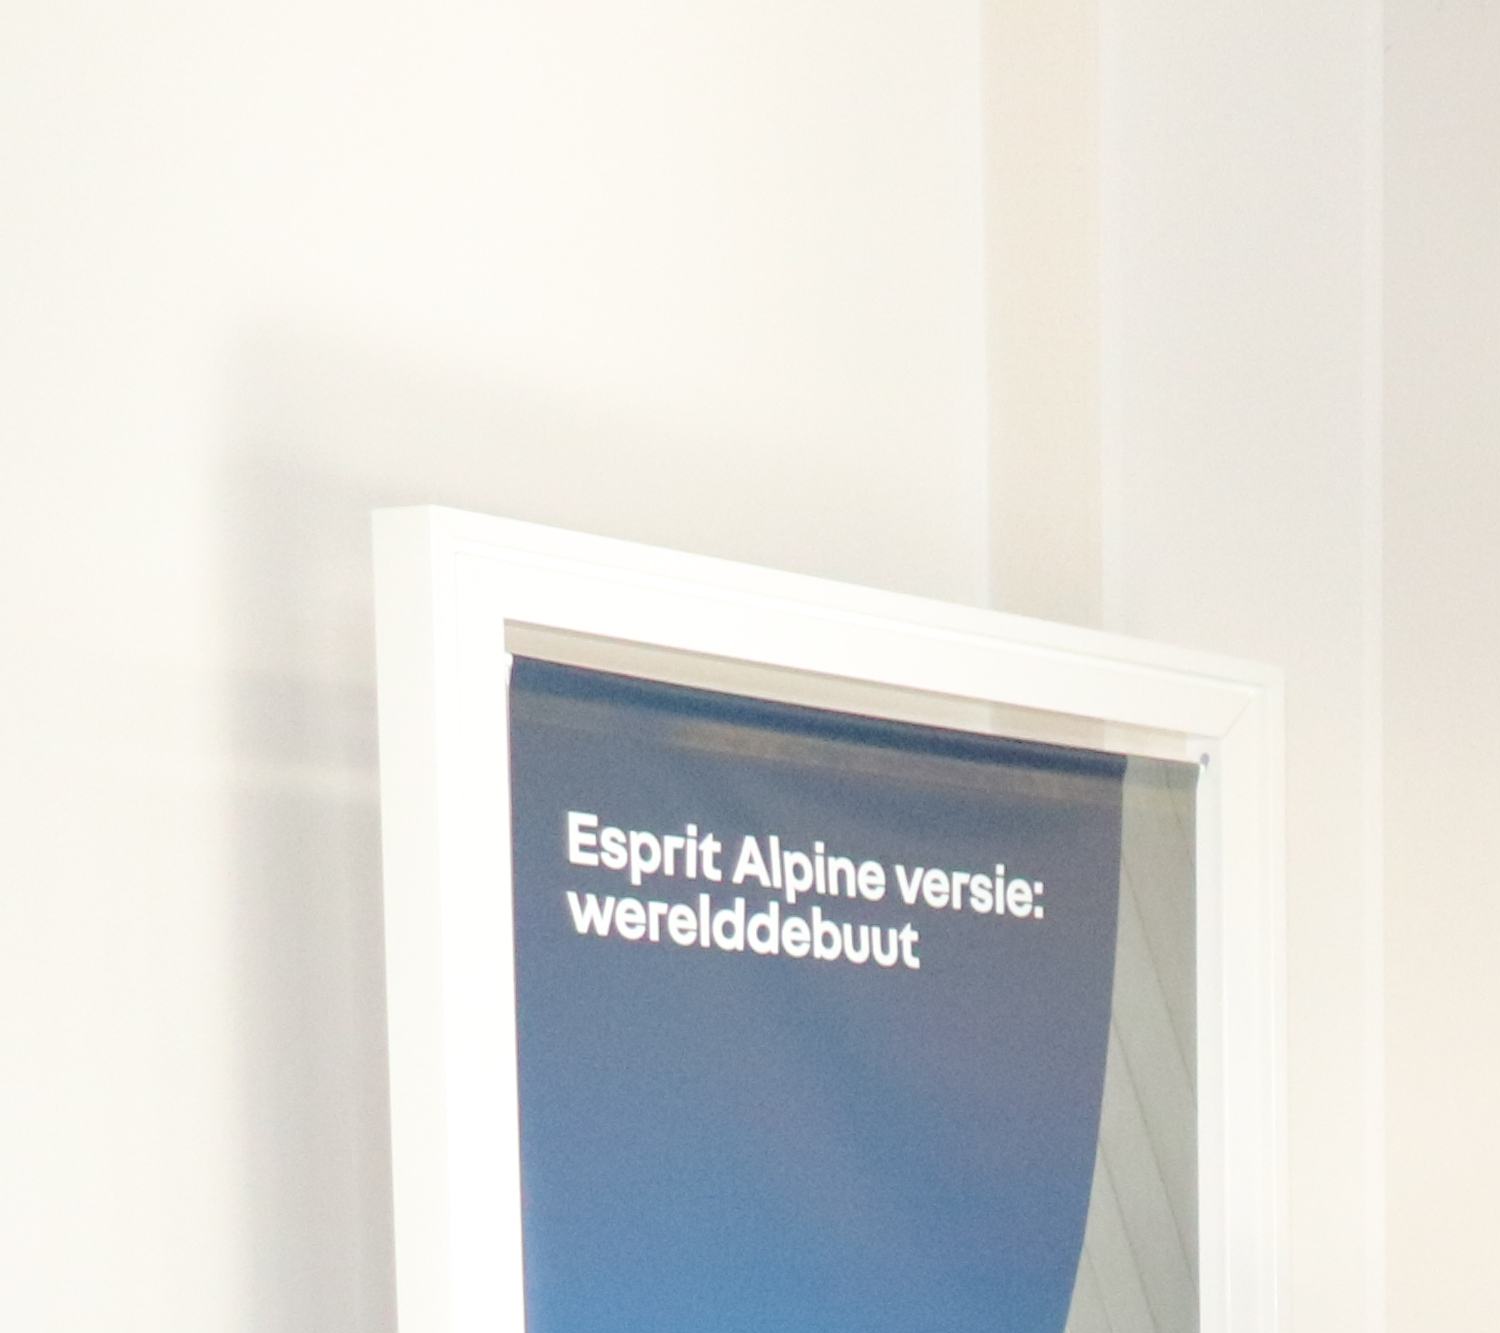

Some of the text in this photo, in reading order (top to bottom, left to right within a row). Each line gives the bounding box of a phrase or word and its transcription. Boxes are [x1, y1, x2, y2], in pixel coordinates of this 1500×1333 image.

[567, 811, 1045, 920] Esprit Alpine versie:
[566, 890, 921, 970] werelddebuut
